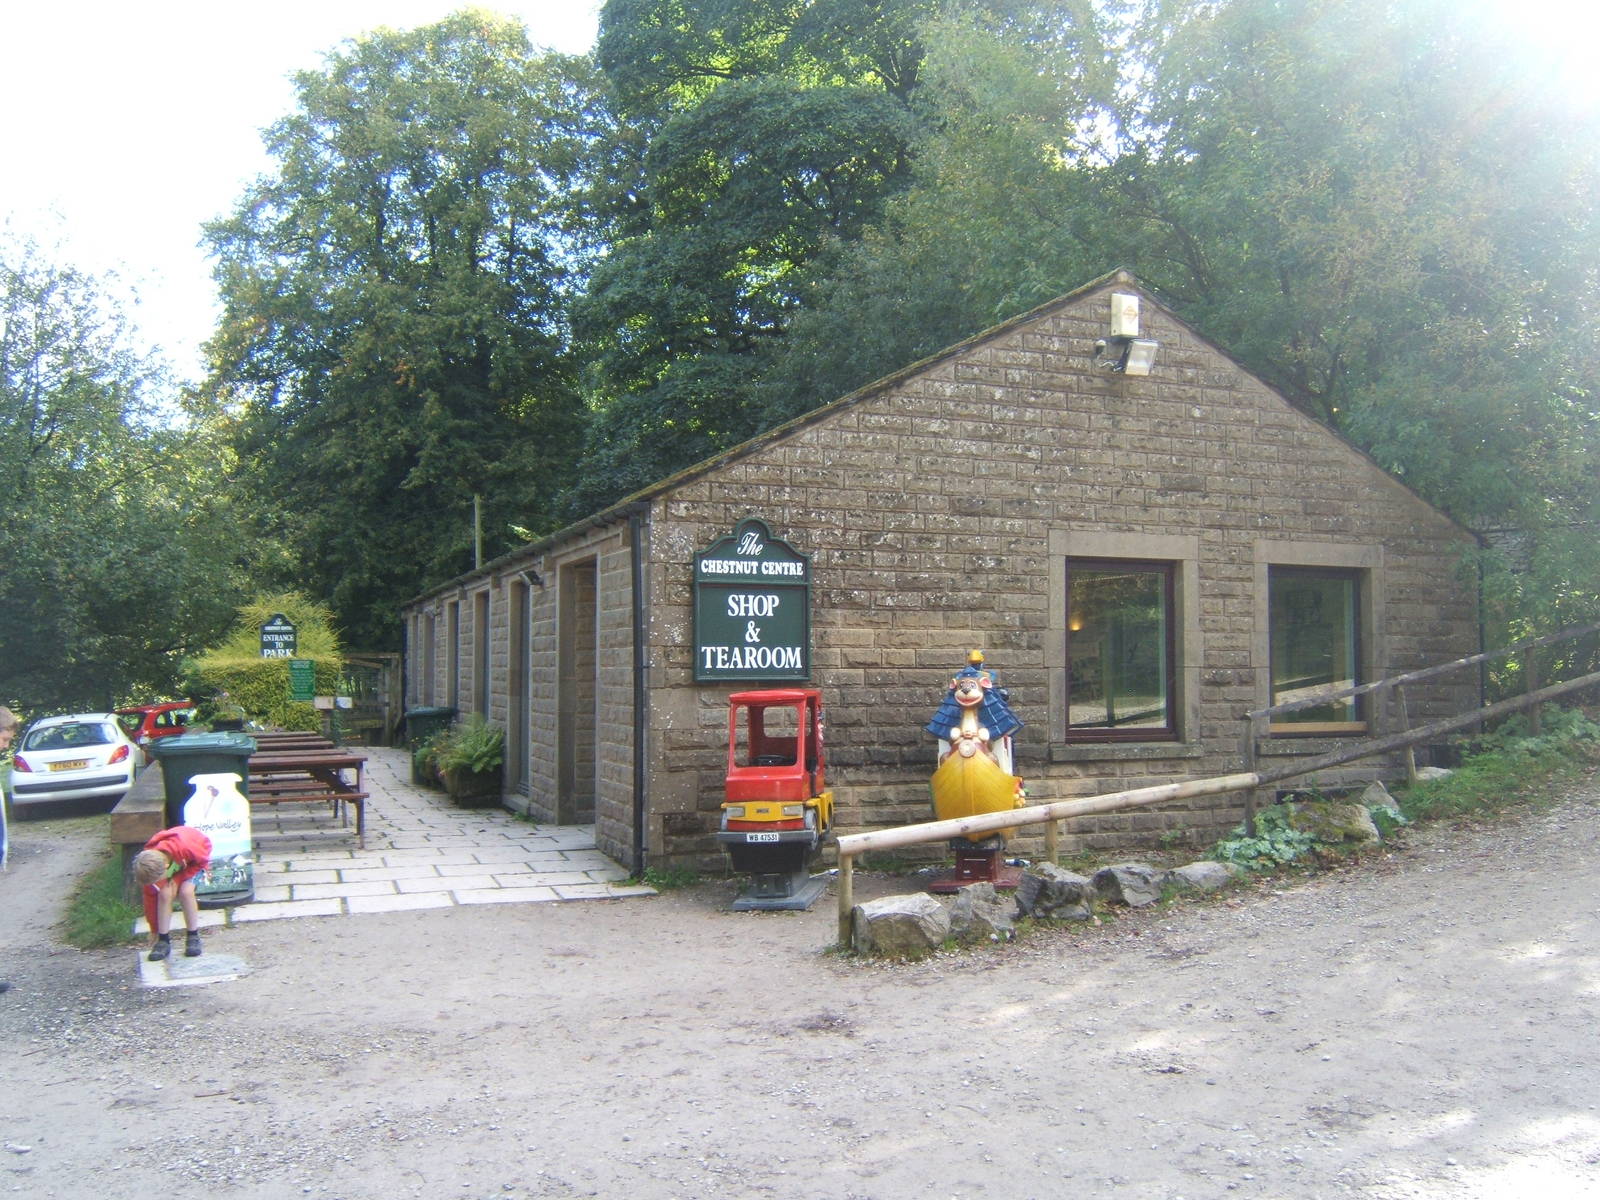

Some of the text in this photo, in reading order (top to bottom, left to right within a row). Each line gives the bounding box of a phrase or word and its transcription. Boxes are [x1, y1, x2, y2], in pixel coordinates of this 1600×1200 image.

[737, 532, 763, 556] The
[701, 560, 804, 576] CHESTNUT CENTRE
[728, 594, 779, 616] SHOP
[263, 634, 294, 642] ENTRANCE
[745, 620, 760, 642] &
[263, 649, 294, 658] PARK
[701, 646, 802, 669] TEAROOM
